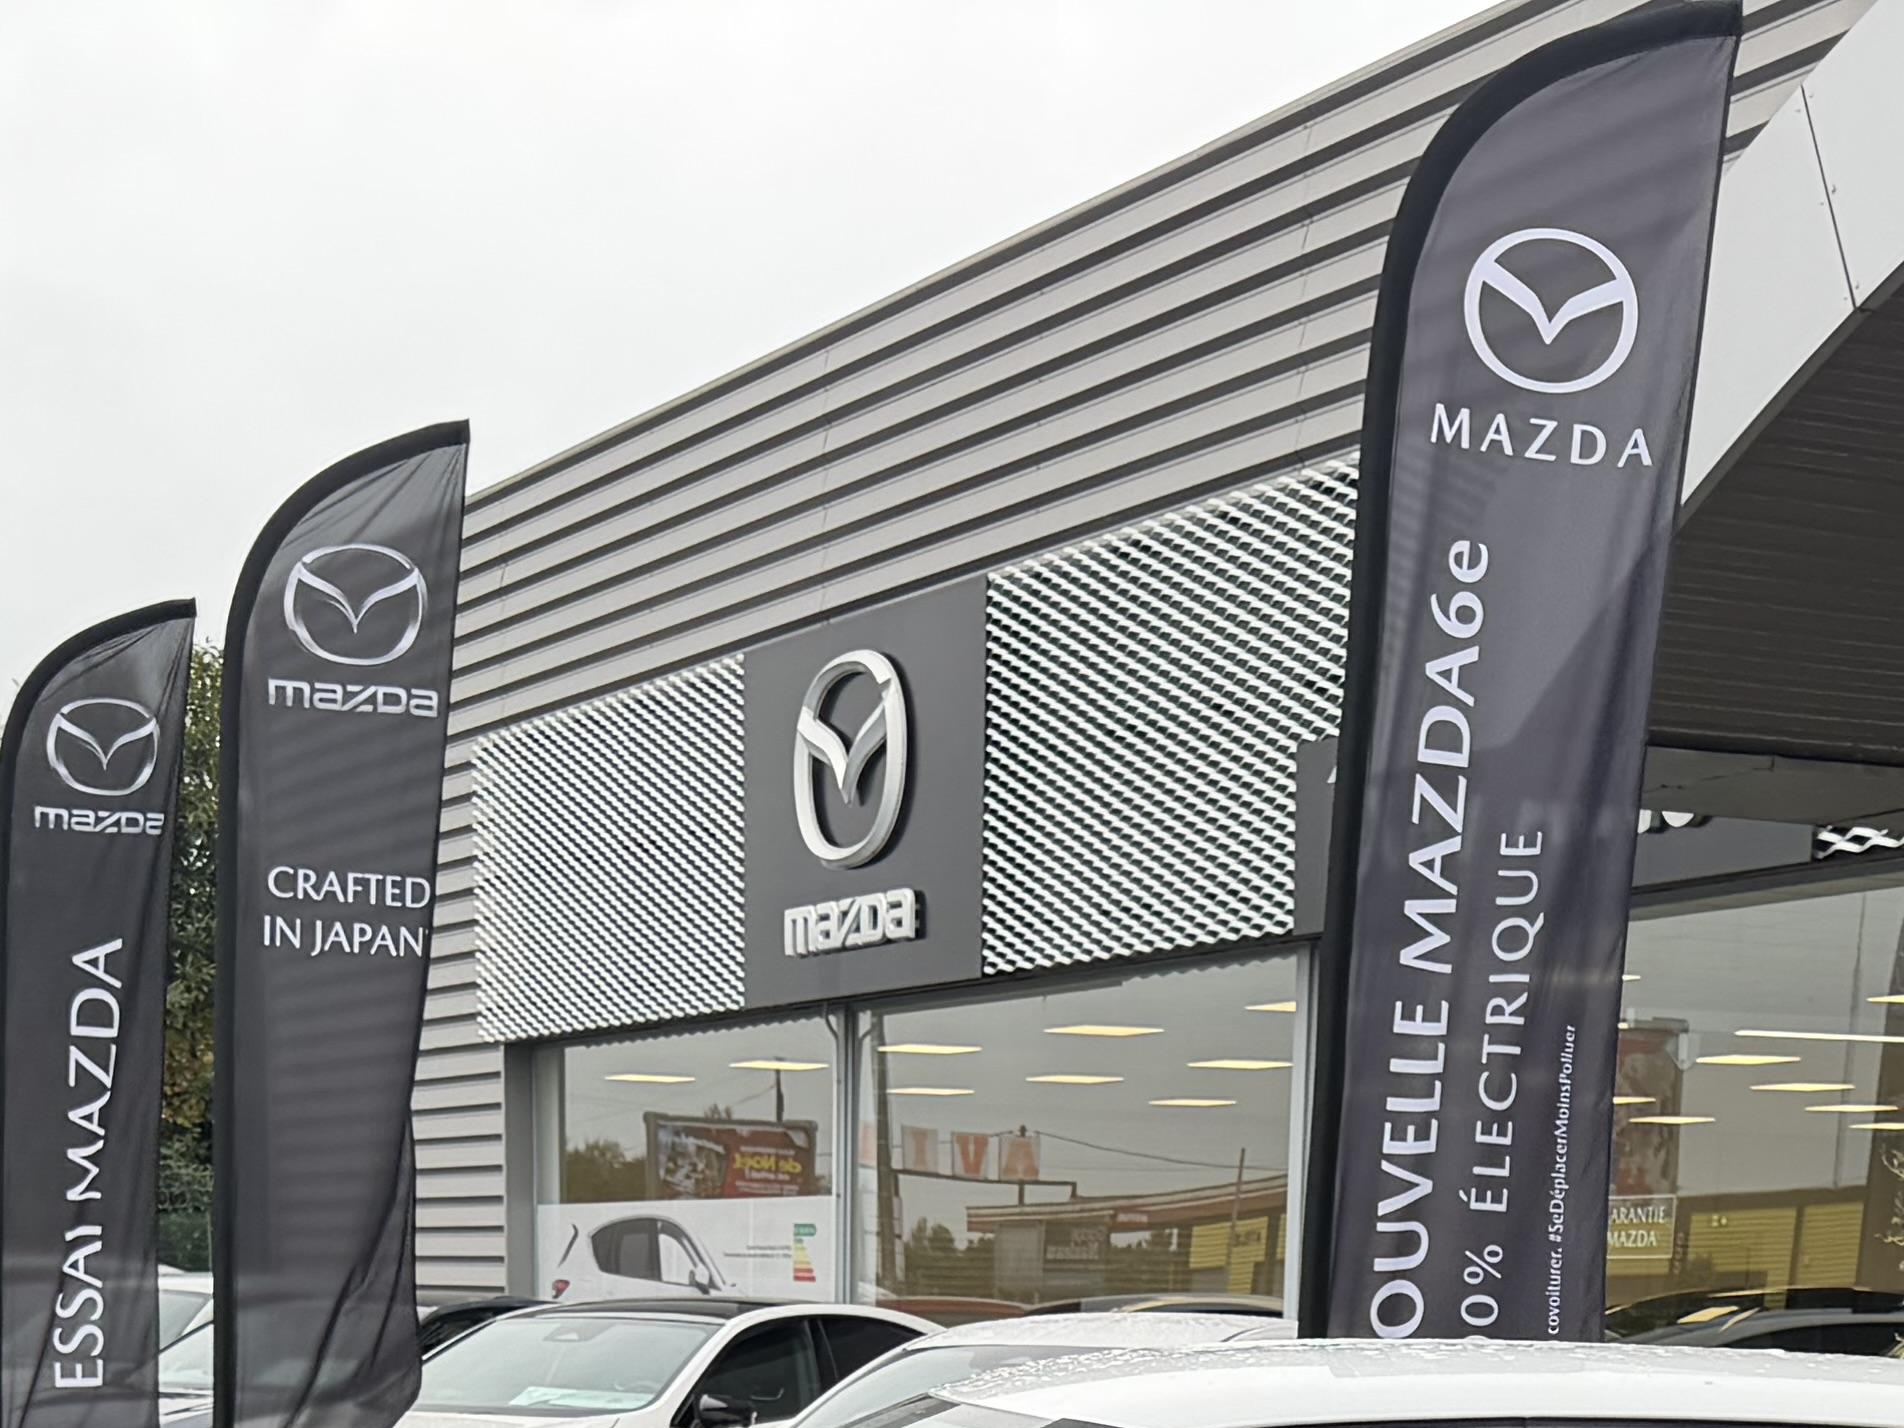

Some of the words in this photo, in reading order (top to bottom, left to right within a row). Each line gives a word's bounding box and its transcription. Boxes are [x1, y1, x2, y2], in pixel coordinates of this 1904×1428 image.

[1430, 403, 1653, 467] MAZDA
[268, 678, 439, 718] mazda
[1399, 540, 1489, 975] MAZDA6e
[263, 915, 302, 949] IN
[267, 866, 430, 908] CRAFTED
[65, 937, 123, 1201] MAZDA
[1458, 830, 1544, 1213] ÉLECTRIQUE
[1369, 1000, 1449, 1340] OUVELLE
[1611, 1205, 1666, 1225] ARANTIE
[54, 1225, 103, 1388] ESSAI
[1459, 1244, 1504, 1340] 0%
